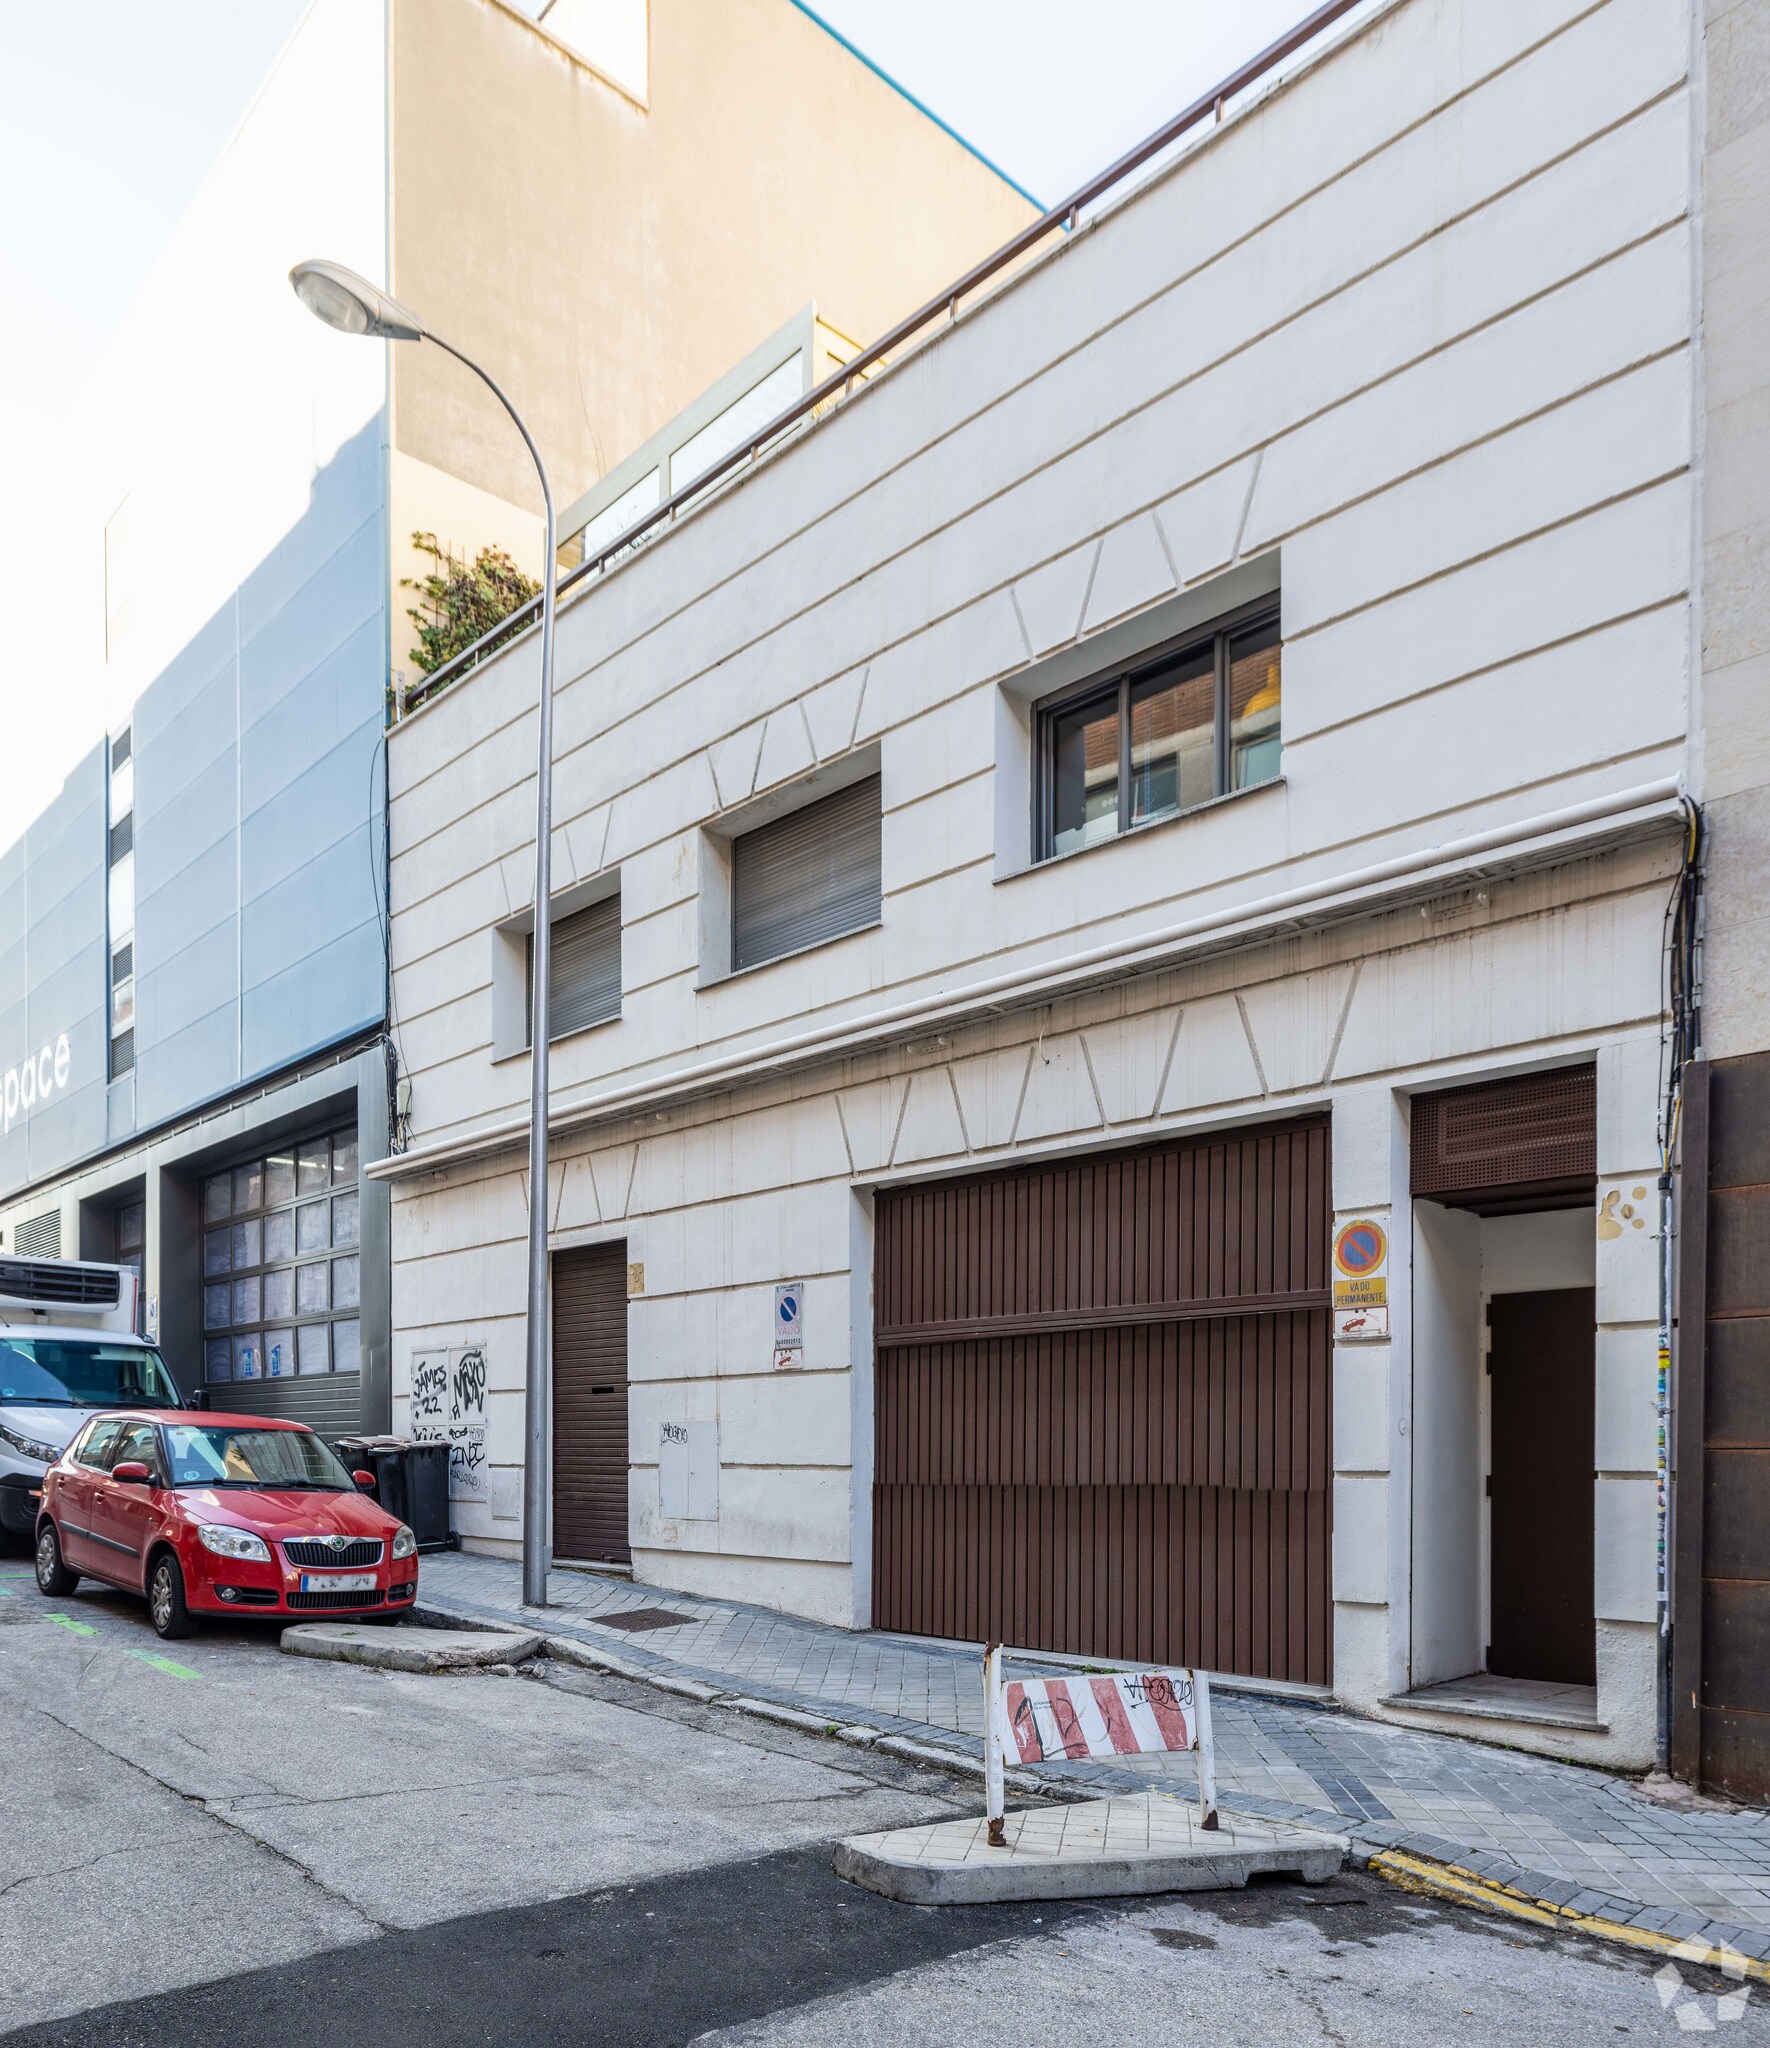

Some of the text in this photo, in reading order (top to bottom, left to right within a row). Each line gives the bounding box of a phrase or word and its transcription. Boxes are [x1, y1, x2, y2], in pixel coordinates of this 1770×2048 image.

[0, 1033, 70, 1134] pace
[1349, 1282, 1370, 1291] VADO
[1336, 1292, 1383, 1305] PERMANENTE
[777, 1325, 800, 1335] VADO
